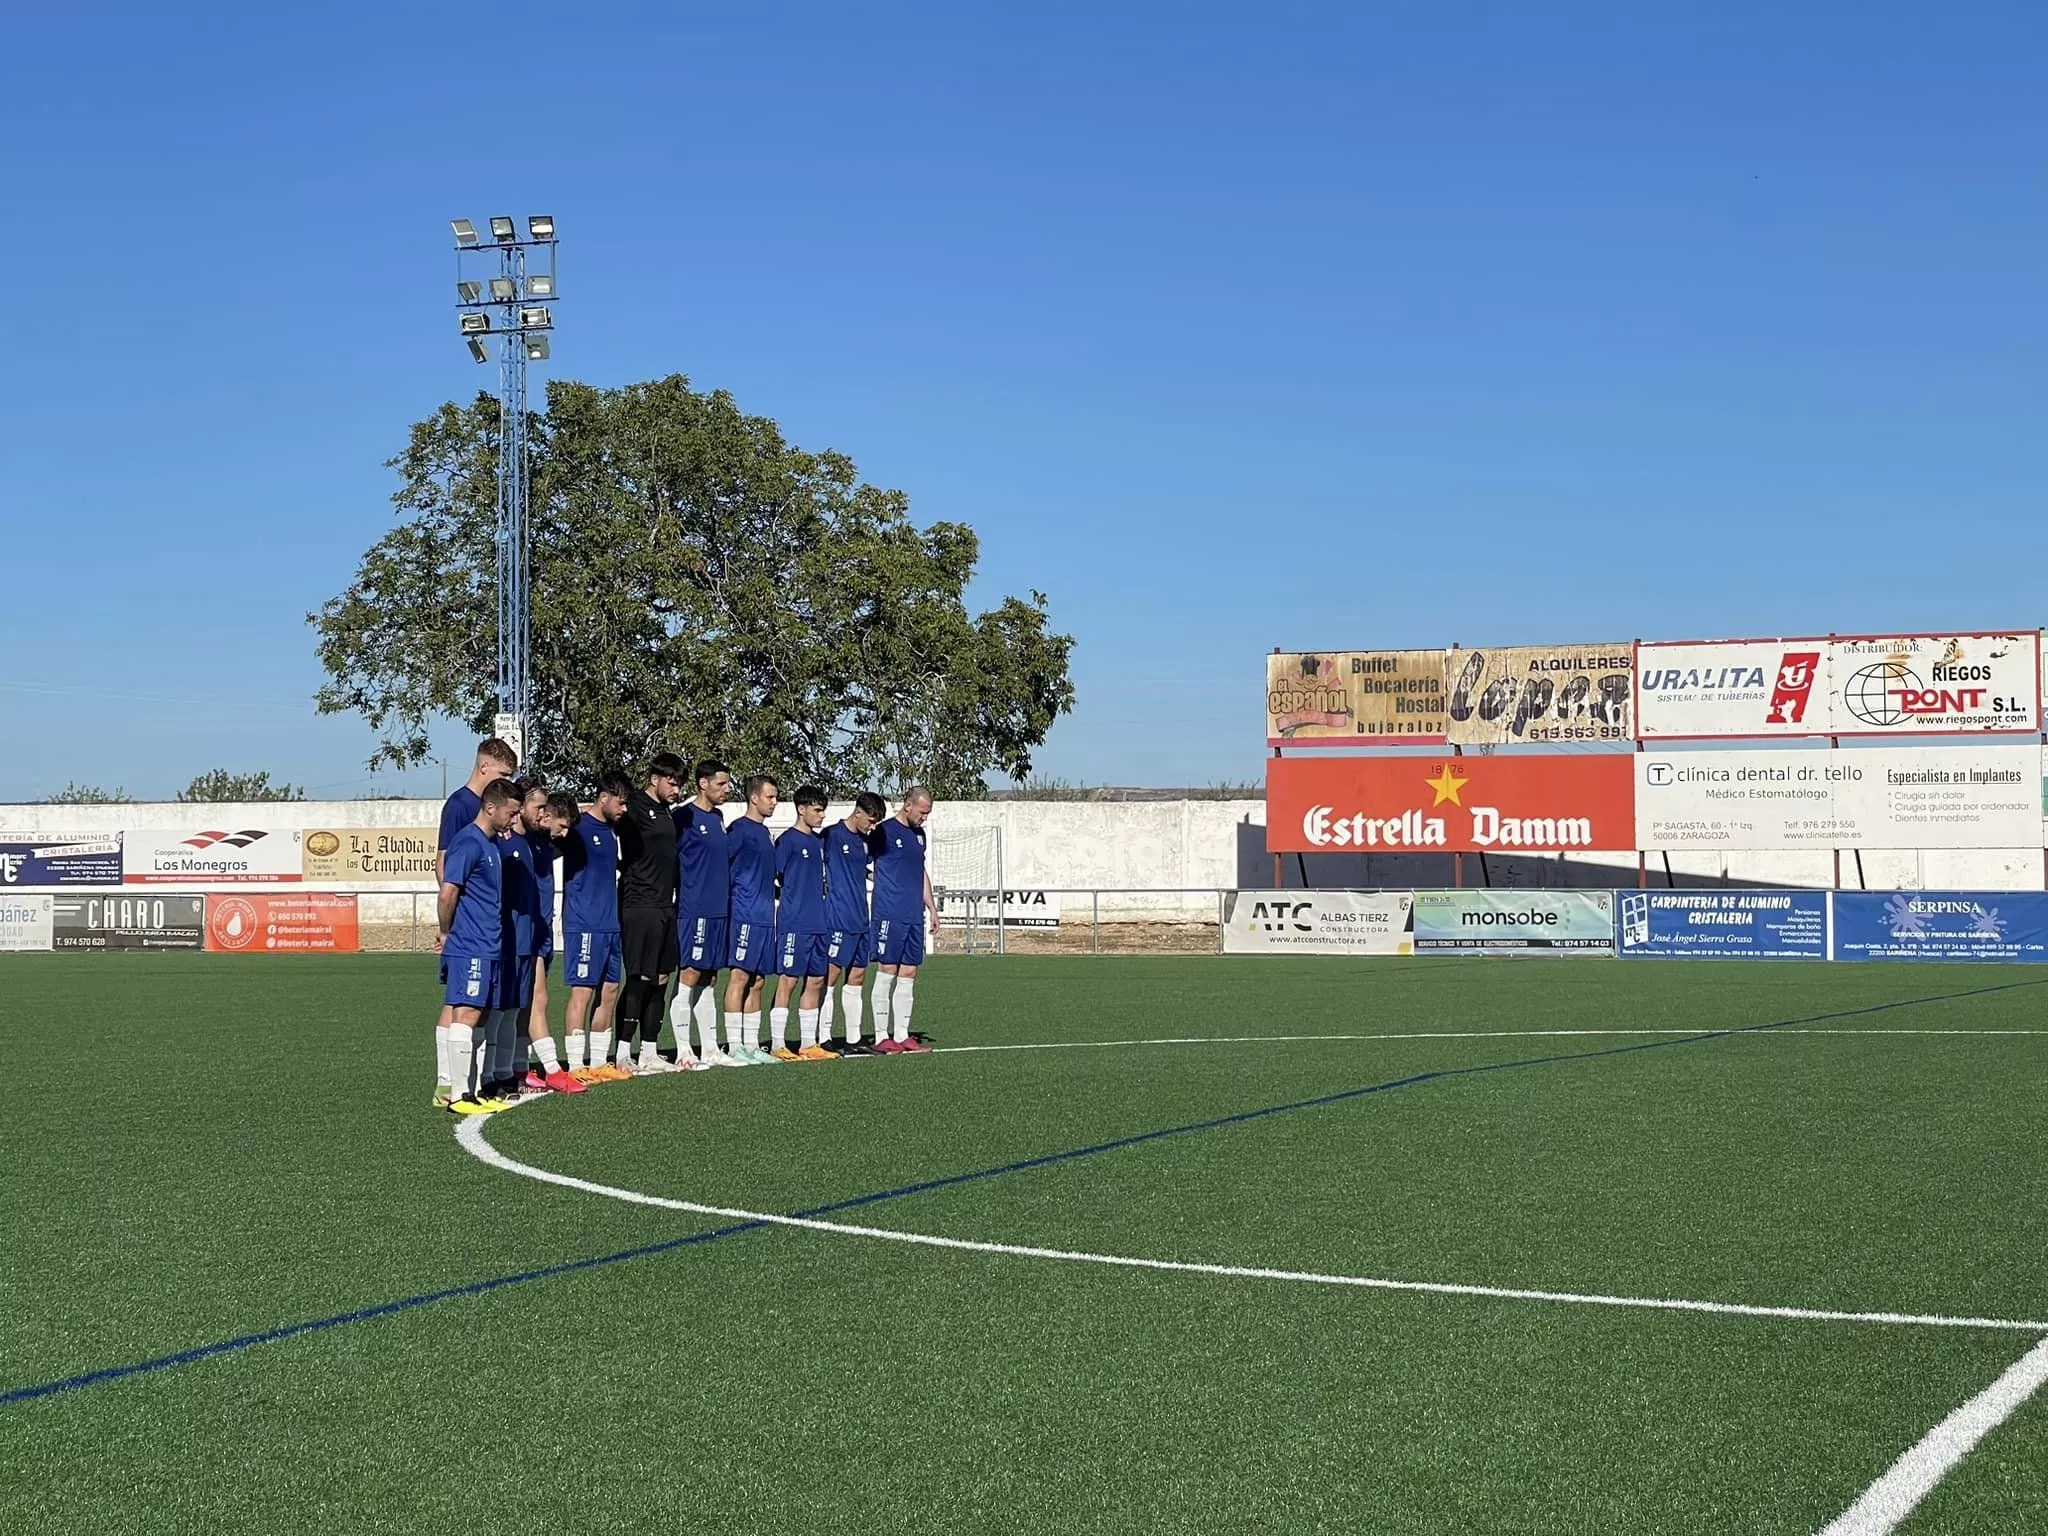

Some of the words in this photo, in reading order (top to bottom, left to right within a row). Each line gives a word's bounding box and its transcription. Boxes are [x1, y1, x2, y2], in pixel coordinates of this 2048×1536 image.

[1352, 658, 1398, 673] Buffet
[1529, 657, 1630, 671] ALQUILERES
[1642, 668, 1764, 690] URALITA
[1933, 666, 1992, 682] RIEGOS
[1364, 676, 1439, 693] Bocatería
[1396, 696, 1445, 713] Hostal
[1888, 688, 1986, 714] PONT
[1993, 697, 2026, 712] S.L.
[1358, 720, 1442, 734] bujaraloz
[1652, 768, 1665, 781] T
[1677, 767, 1730, 782] clínica
[1736, 766, 1790, 781] dental
[1797, 766, 1818, 781] dr.
[1825, 766, 1862, 781] tello
[1888, 769, 1949, 785] Especialista
[1954, 772, 1966, 782] en
[1970, 768, 2022, 784] Implantes
[1706, 789, 1745, 799] Médico
[1750, 789, 1828, 800] Estomatólogo
[1928, 802, 1961, 812] guiada
[1964, 804, 1978, 812] por
[1980, 802, 2029, 810] ordenador
[1304, 804, 1447, 846] Estrella
[1470, 806, 1592, 846] Damm
[1803, 821, 1818, 829] 976
[1821, 821, 1837, 829] 279
[1840, 821, 1855, 829] 550
[1653, 832, 1678, 840] 50006
[1680, 832, 1730, 840] ZARAGOZA
[350, 836, 369, 853] La
[378, 836, 424, 853] Abadia
[154, 859, 178, 870] Los
[181, 859, 247, 872] Monegros
[347, 859, 358, 868] los
[361, 855, 436, 875] Templarios
[1651, 896, 1718, 909] CARPINTERIA
[1722, 896, 1735, 908] DE
[1738, 896, 1790, 909] ALUMINIO
[1908, 902, 1982, 914] SERPINSA
[88, 900, 164, 928] CHARO
[1252, 902, 1312, 931] ATC
[1320, 914, 1356, 922] ALBAS
[1358, 913, 1389, 922] TIERZ
[1462, 908, 1558, 925] monsobe
[1688, 912, 1752, 924] CRISTALERIA
[64, 938, 77, 946] 974
[79, 938, 91, 946] 570
[1699, 934, 1725, 942] Sierra
